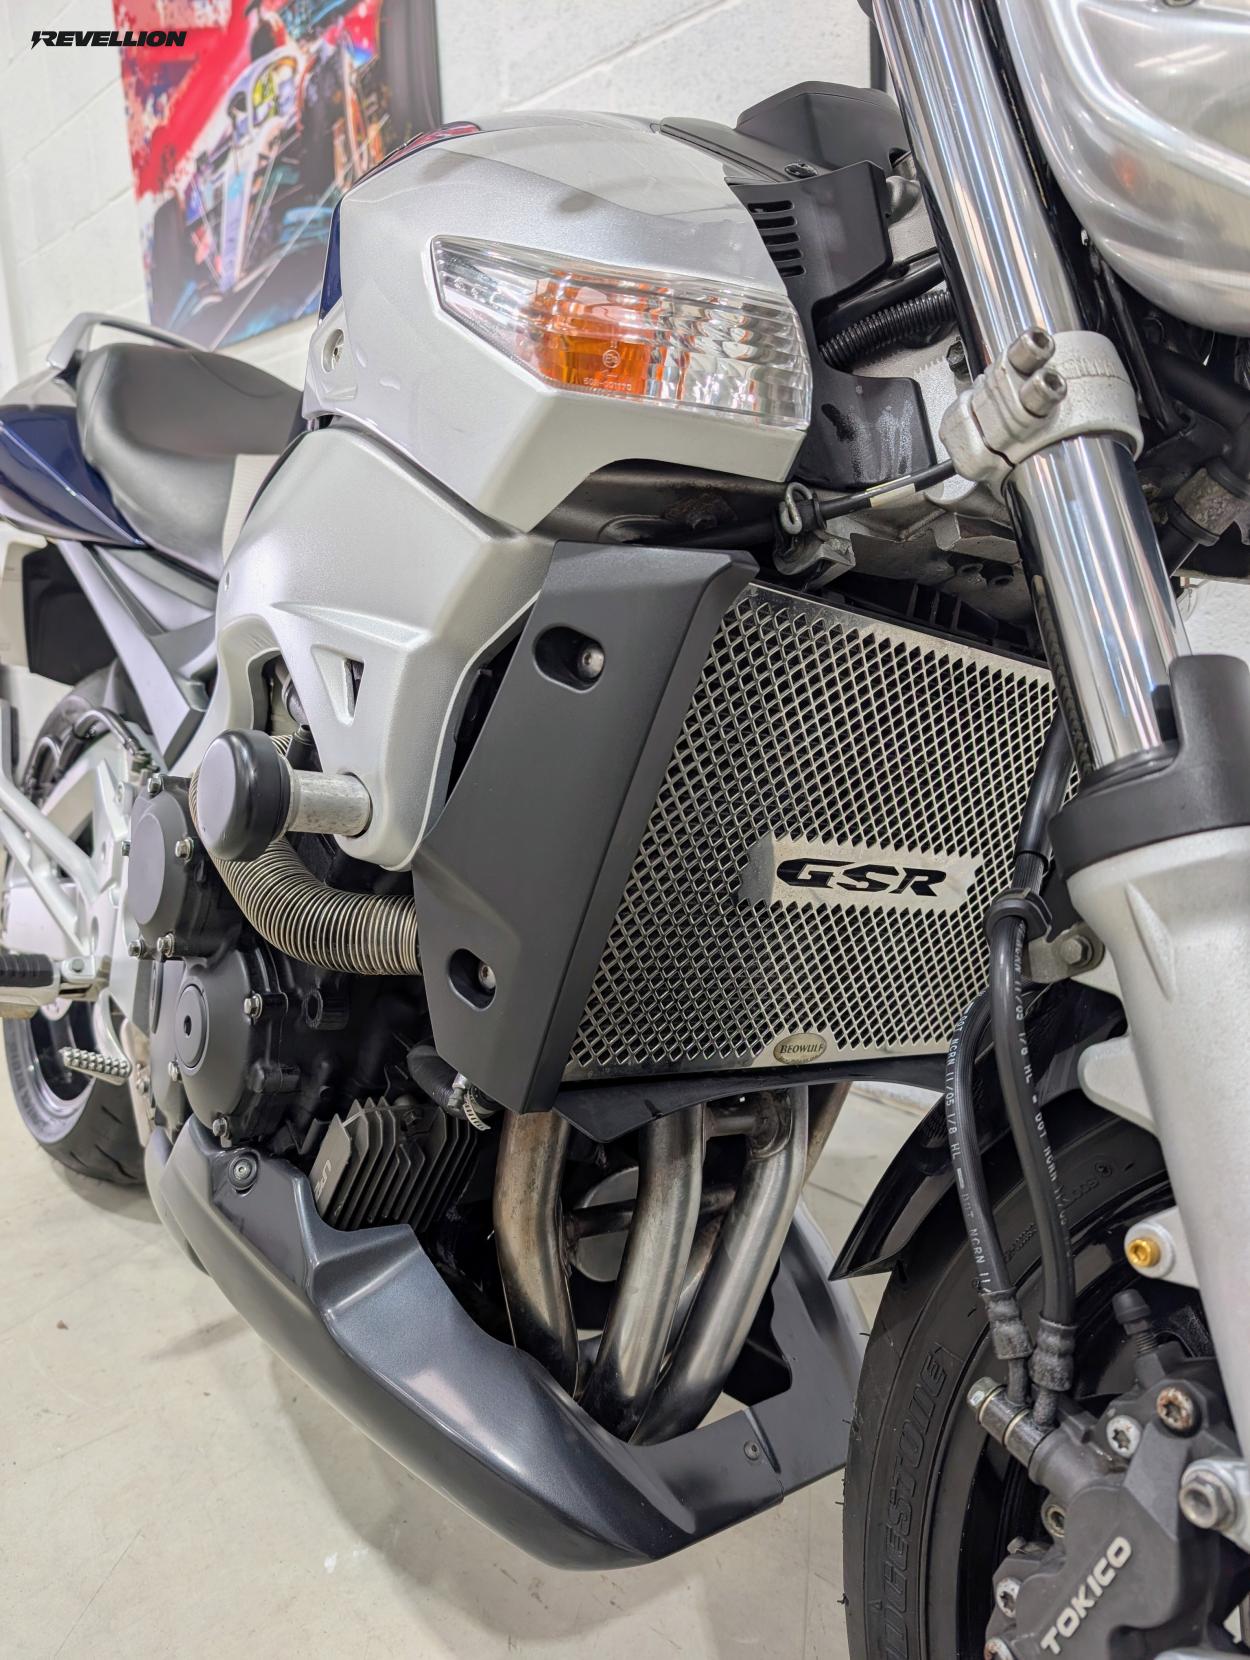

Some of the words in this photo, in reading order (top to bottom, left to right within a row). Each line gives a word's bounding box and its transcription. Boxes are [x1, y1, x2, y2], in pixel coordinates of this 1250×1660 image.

[777, 858, 947, 897] GSR
[780, 1043, 824, 1054] BEOWULF
[950, 1143, 961, 1160] HL
[969, 1228, 986, 1264] NCRN
[1041, 1536, 1132, 1654] TOKICO
